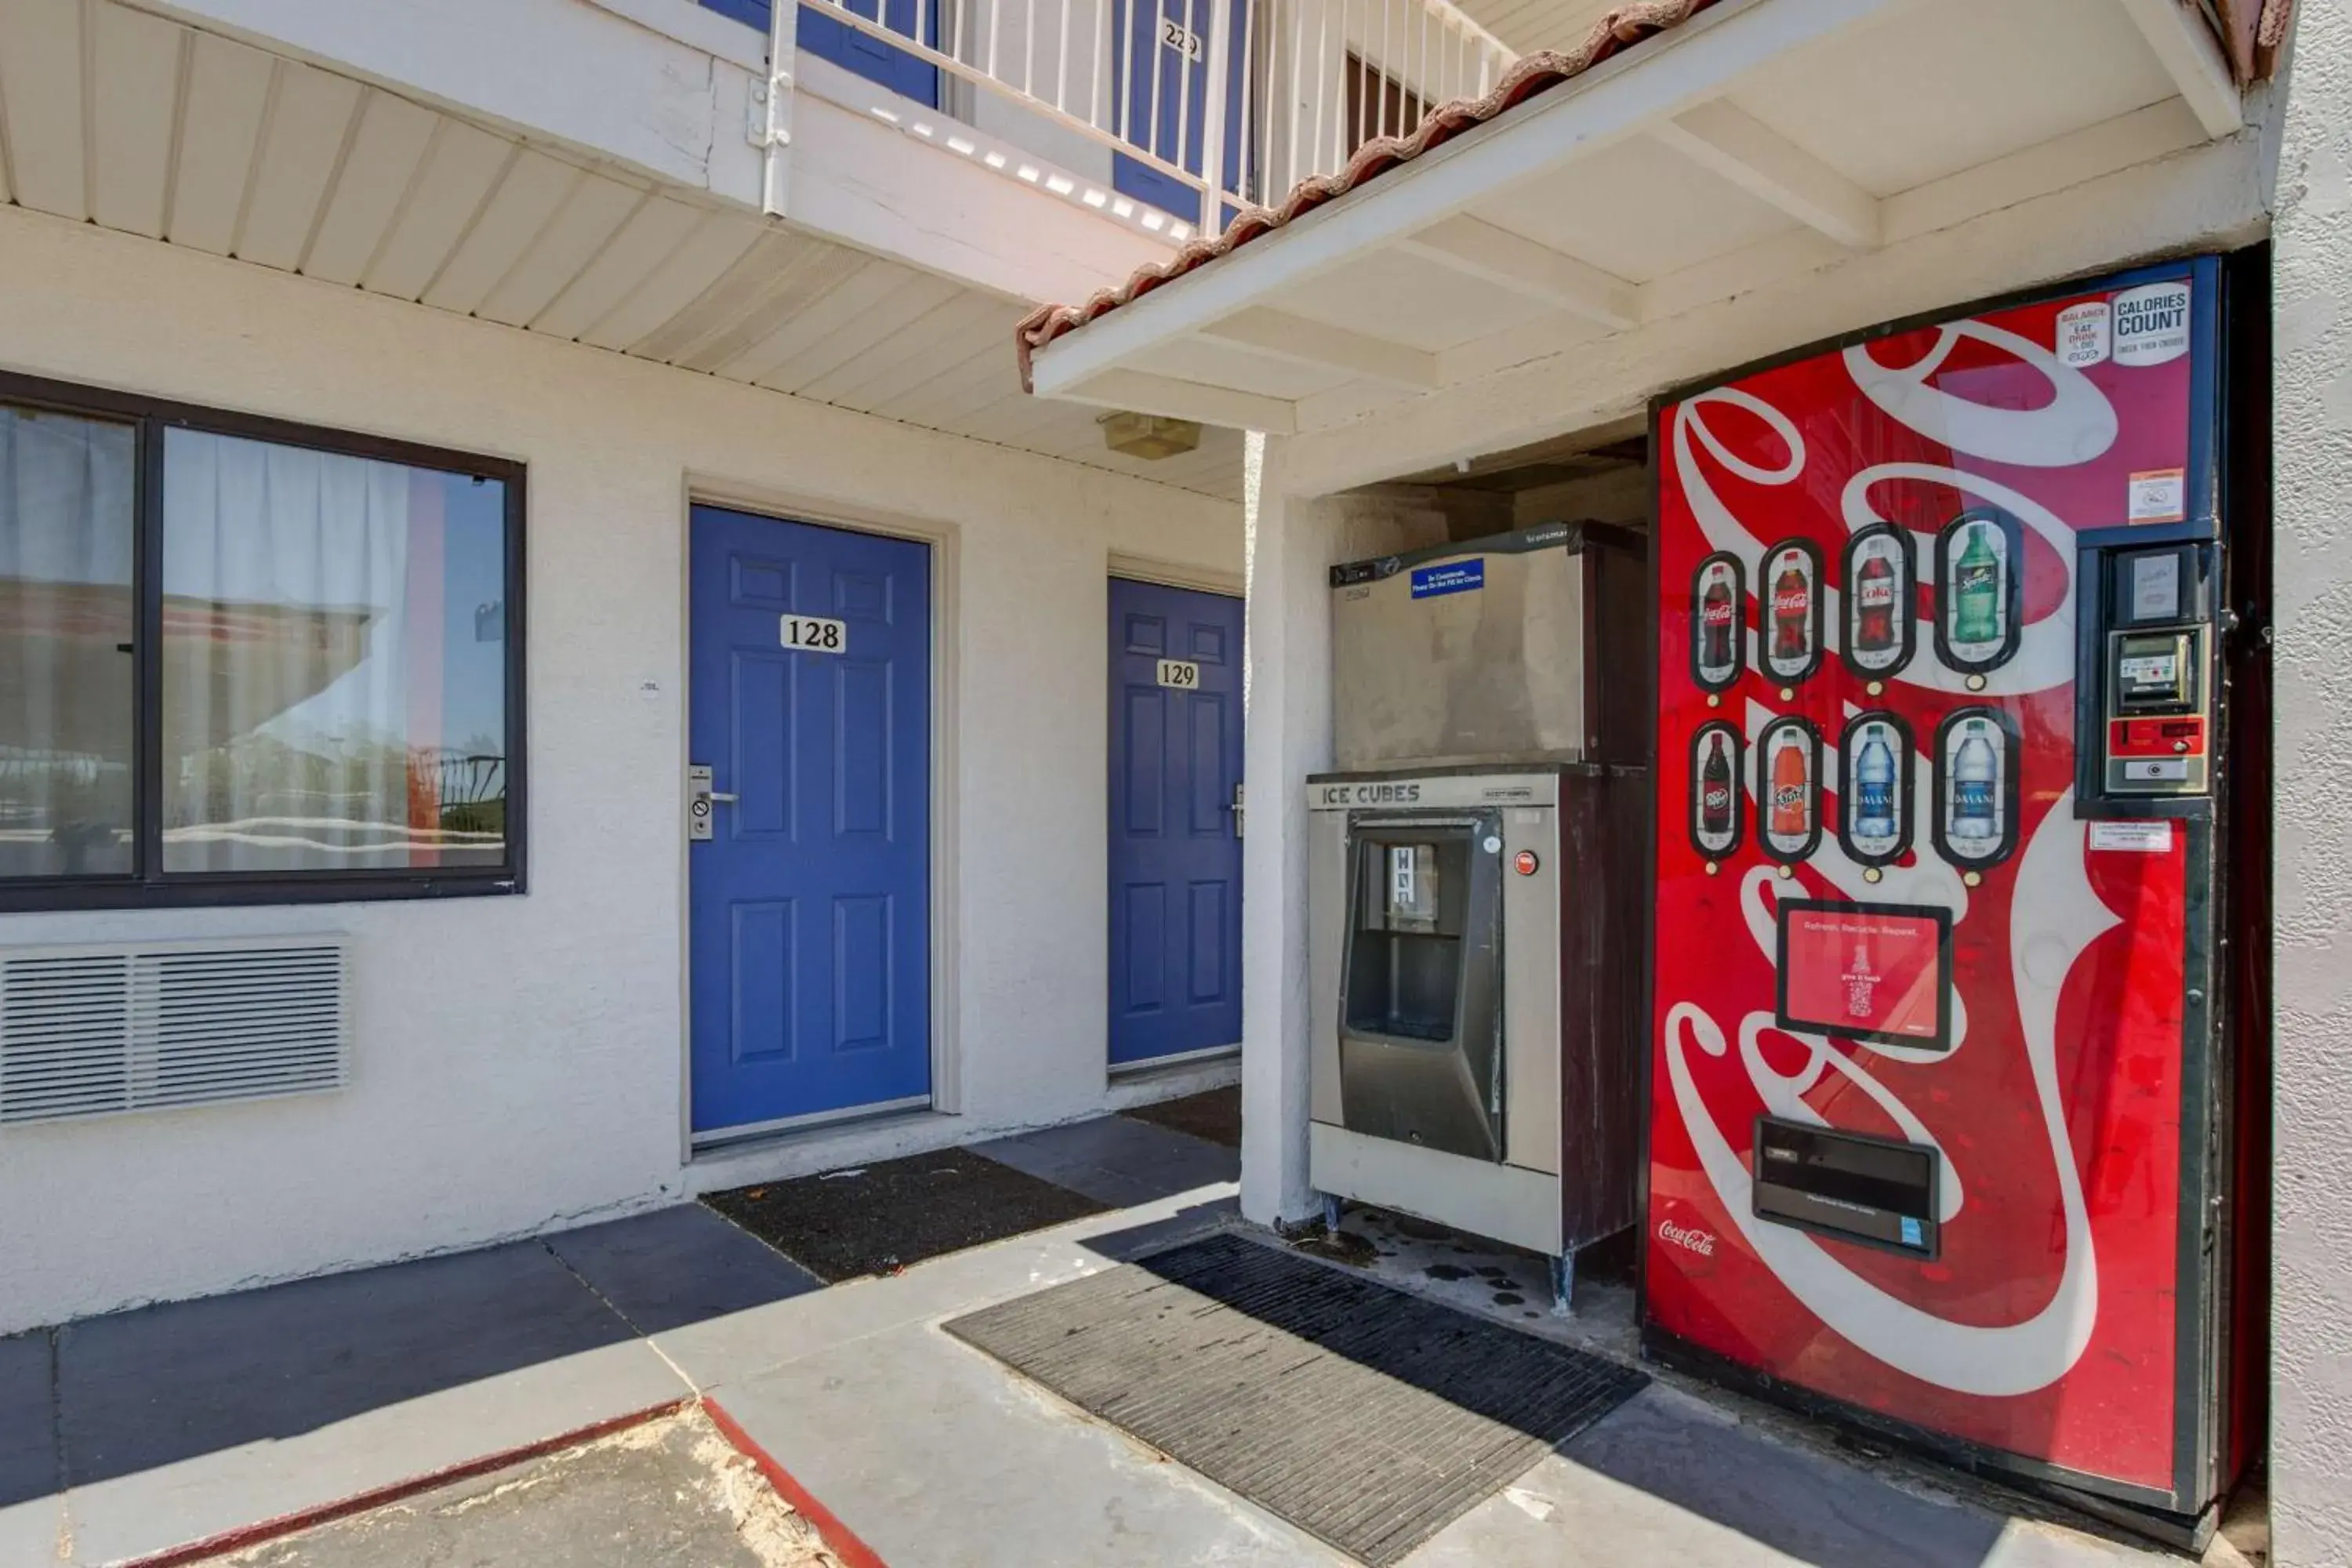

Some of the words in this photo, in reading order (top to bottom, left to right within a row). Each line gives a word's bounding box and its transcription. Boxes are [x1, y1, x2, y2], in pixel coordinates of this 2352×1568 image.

[2118, 292, 2186, 315] CALORIES
[2074, 324, 2092, 333] EAT
[2118, 309, 2185, 336] COUNT
[789, 620, 838, 648] 128
[1163, 664, 1194, 685] 129
[1323, 787, 1349, 804] ICE
[1357, 785, 1420, 804] CUBES
[1658, 1219, 1715, 1256] Coca-Cola
